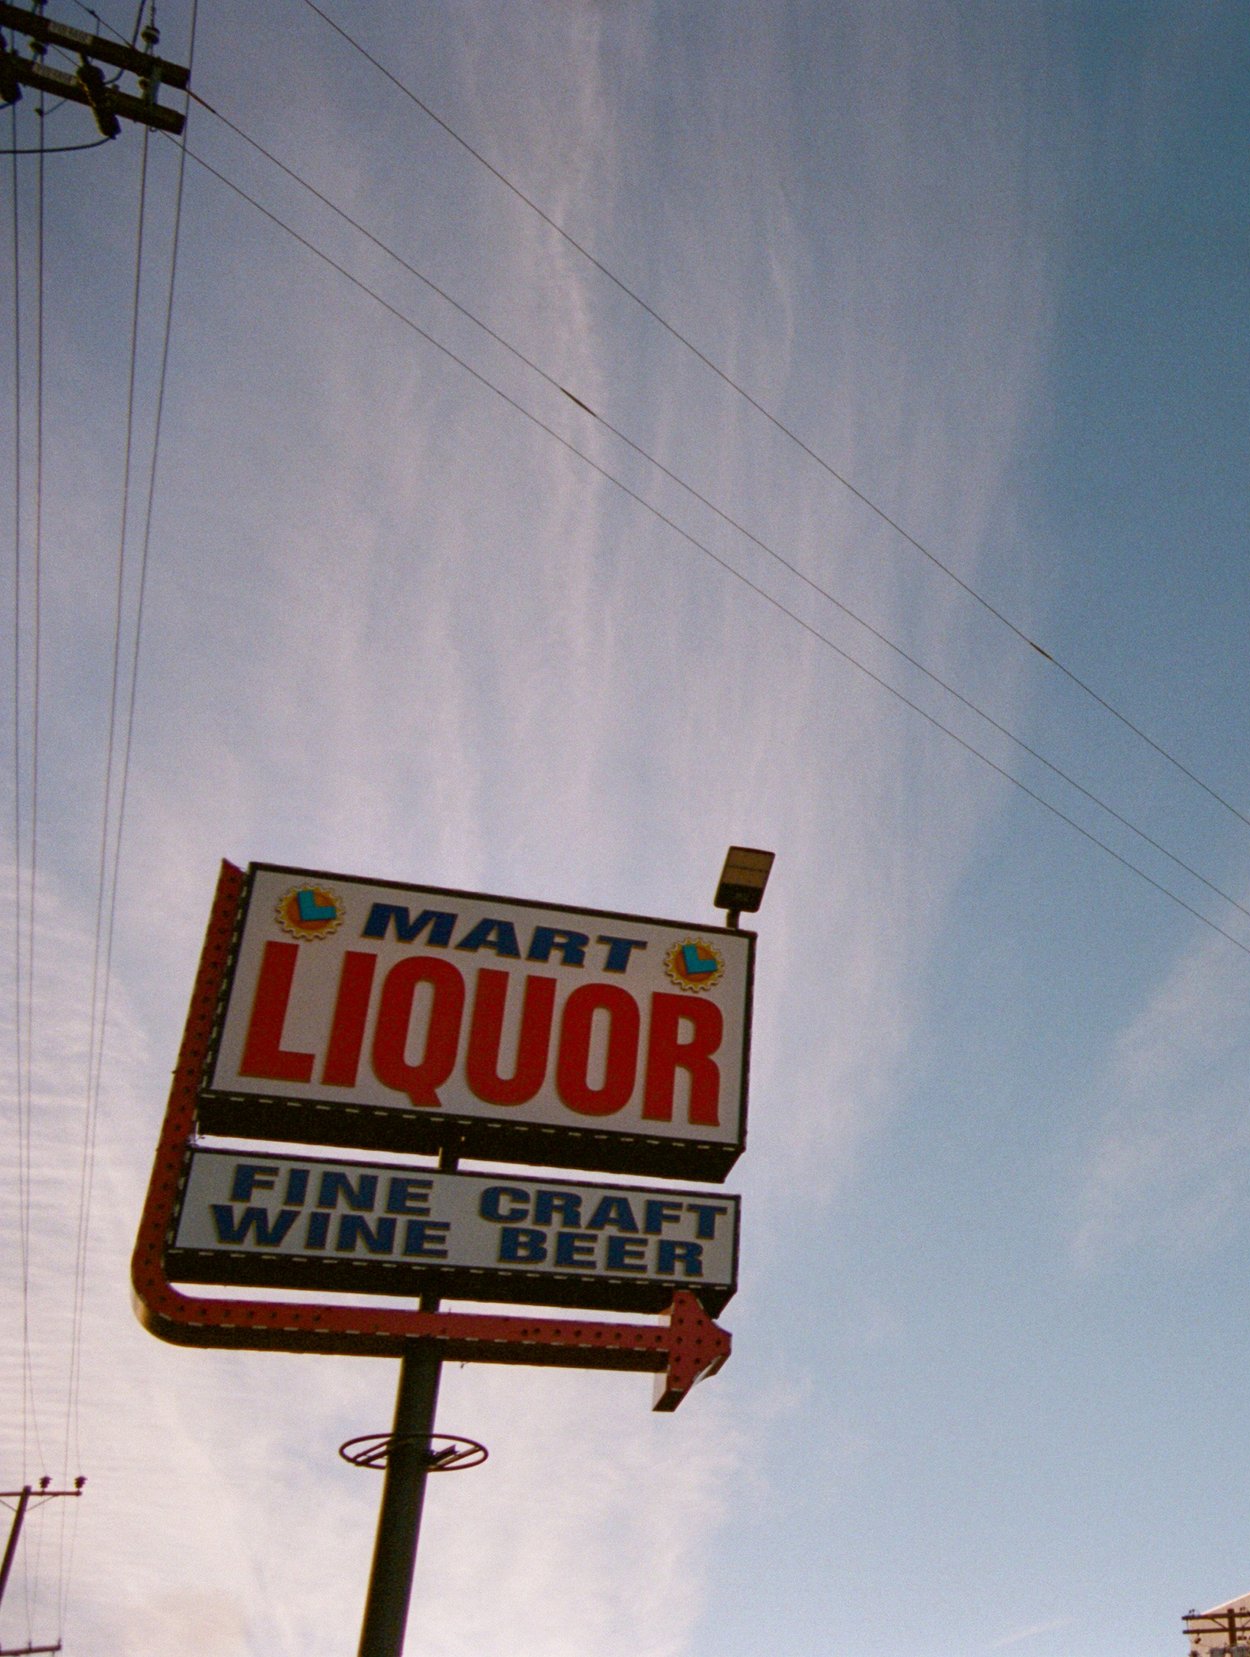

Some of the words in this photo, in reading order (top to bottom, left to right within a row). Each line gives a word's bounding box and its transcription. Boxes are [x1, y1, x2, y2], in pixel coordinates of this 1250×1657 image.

[361, 903, 647, 973] MART
[238, 940, 724, 1126] LIQUOR
[229, 1164, 434, 1217] FINE
[479, 1185, 727, 1240] CRAFT
[211, 1205, 451, 1257] WINE
[499, 1227, 704, 1277] BEER
